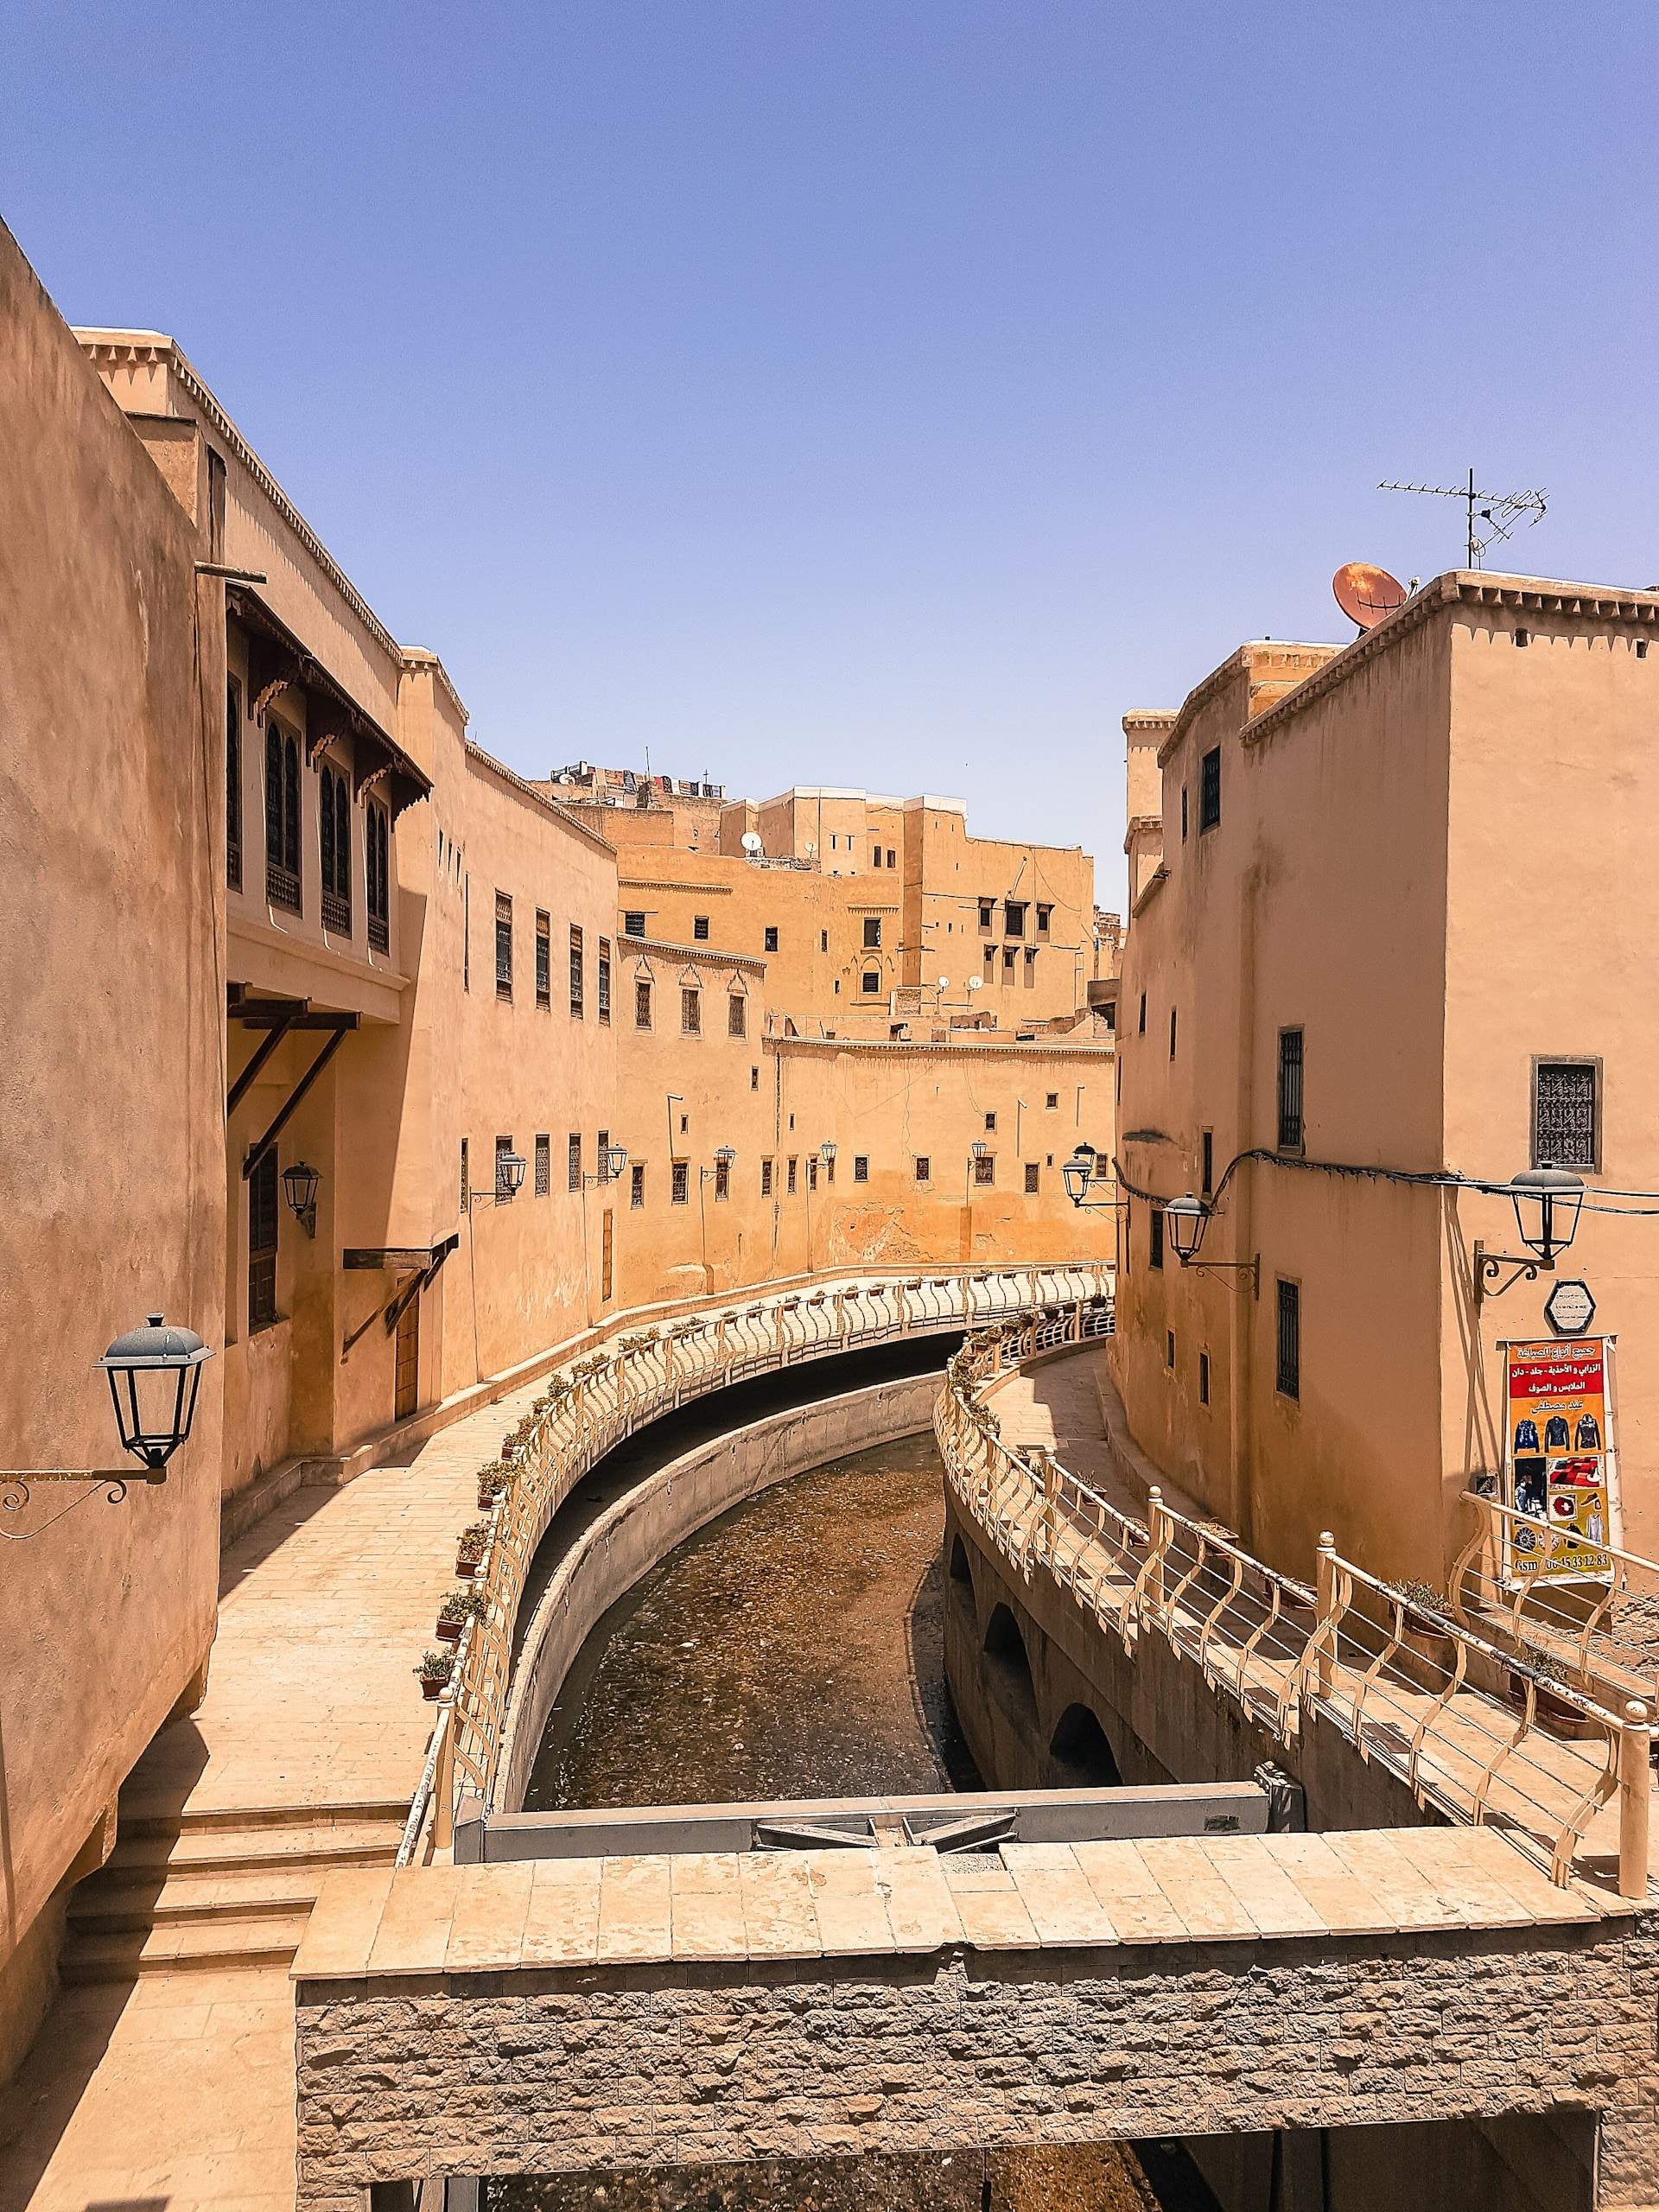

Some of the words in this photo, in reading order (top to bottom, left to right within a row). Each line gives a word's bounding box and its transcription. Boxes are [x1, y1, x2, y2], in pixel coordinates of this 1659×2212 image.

[1552, 1343, 1571, 1360] أنواع
[1573, 1348, 1594, 1359] جميع
[1530, 1367, 1543, 1376] جلد
[1548, 1363, 1572, 1376] الأحذية
[1579, 1363, 1601, 1376] الزرابي
[1529, 1383, 1552, 1394] الصوف
[1559, 1382, 1586, 1392] الملابس
[1568, 1400, 1583, 1410] عند
[1516, 1559, 1537, 1571] Gsm
[1573, 1556, 1583, 1567] 33
[1584, 1555, 1594, 1567] 12
[1597, 1554, 1607, 1566] 83
